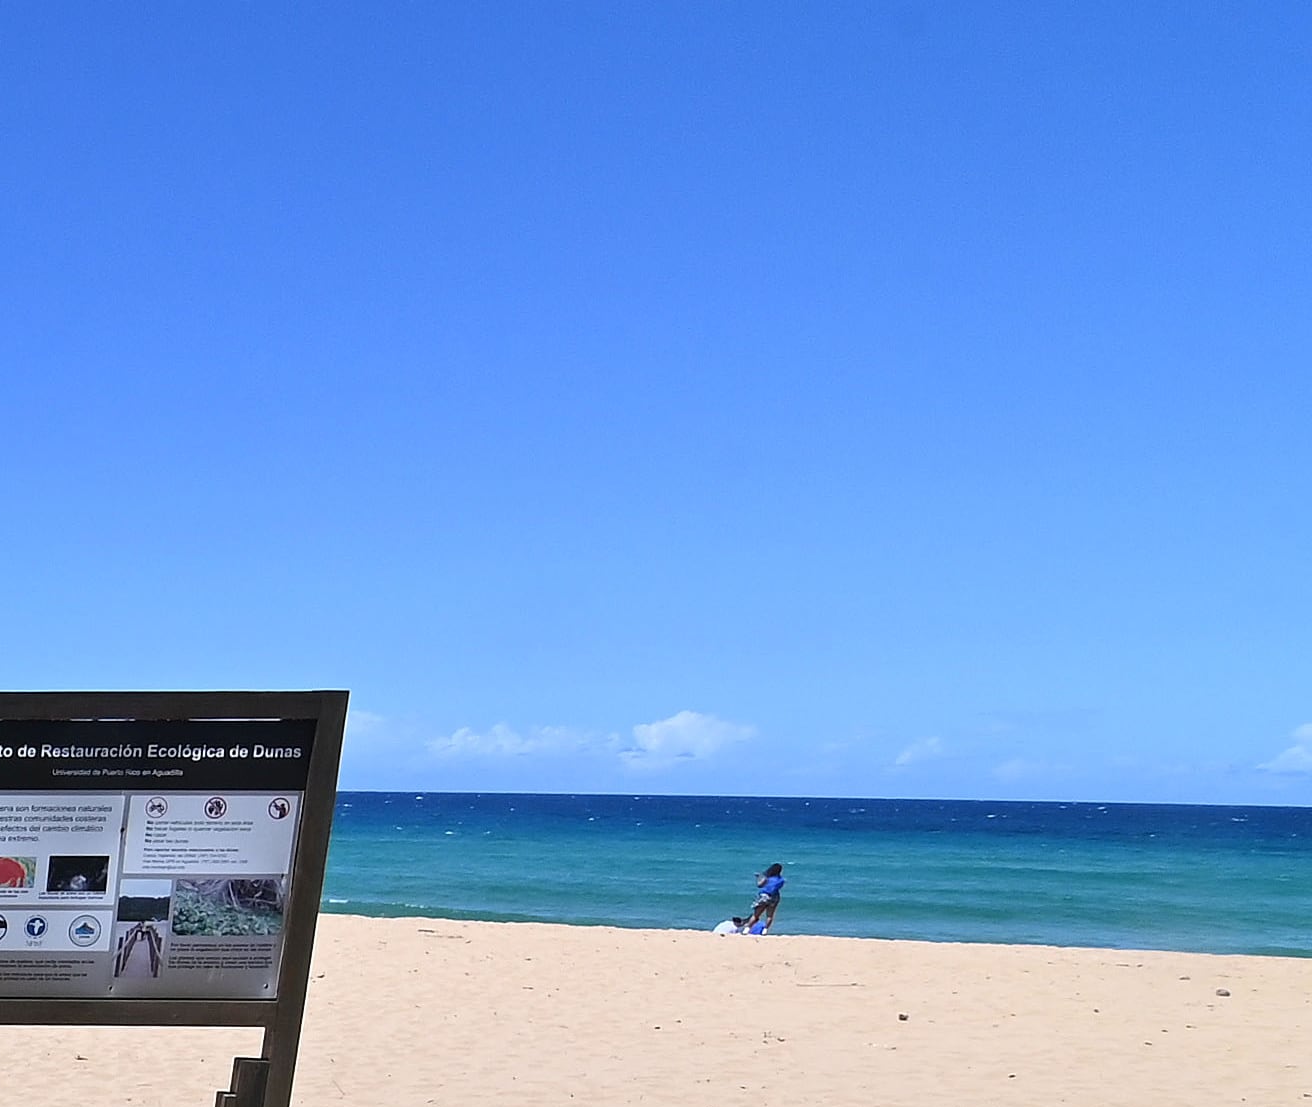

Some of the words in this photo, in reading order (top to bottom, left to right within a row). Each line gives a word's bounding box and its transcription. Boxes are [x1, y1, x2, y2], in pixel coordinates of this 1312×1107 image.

[17, 744, 36, 758] de
[41, 744, 142, 758] Restauración
[147, 744, 225, 761] Ecológica
[229, 745, 248, 758] de
[253, 745, 302, 758] Dunas
[52, 768, 91, 776] Universidad
[102, 768, 124, 776] Puerto
[152, 769, 184, 777] Aguadilla
